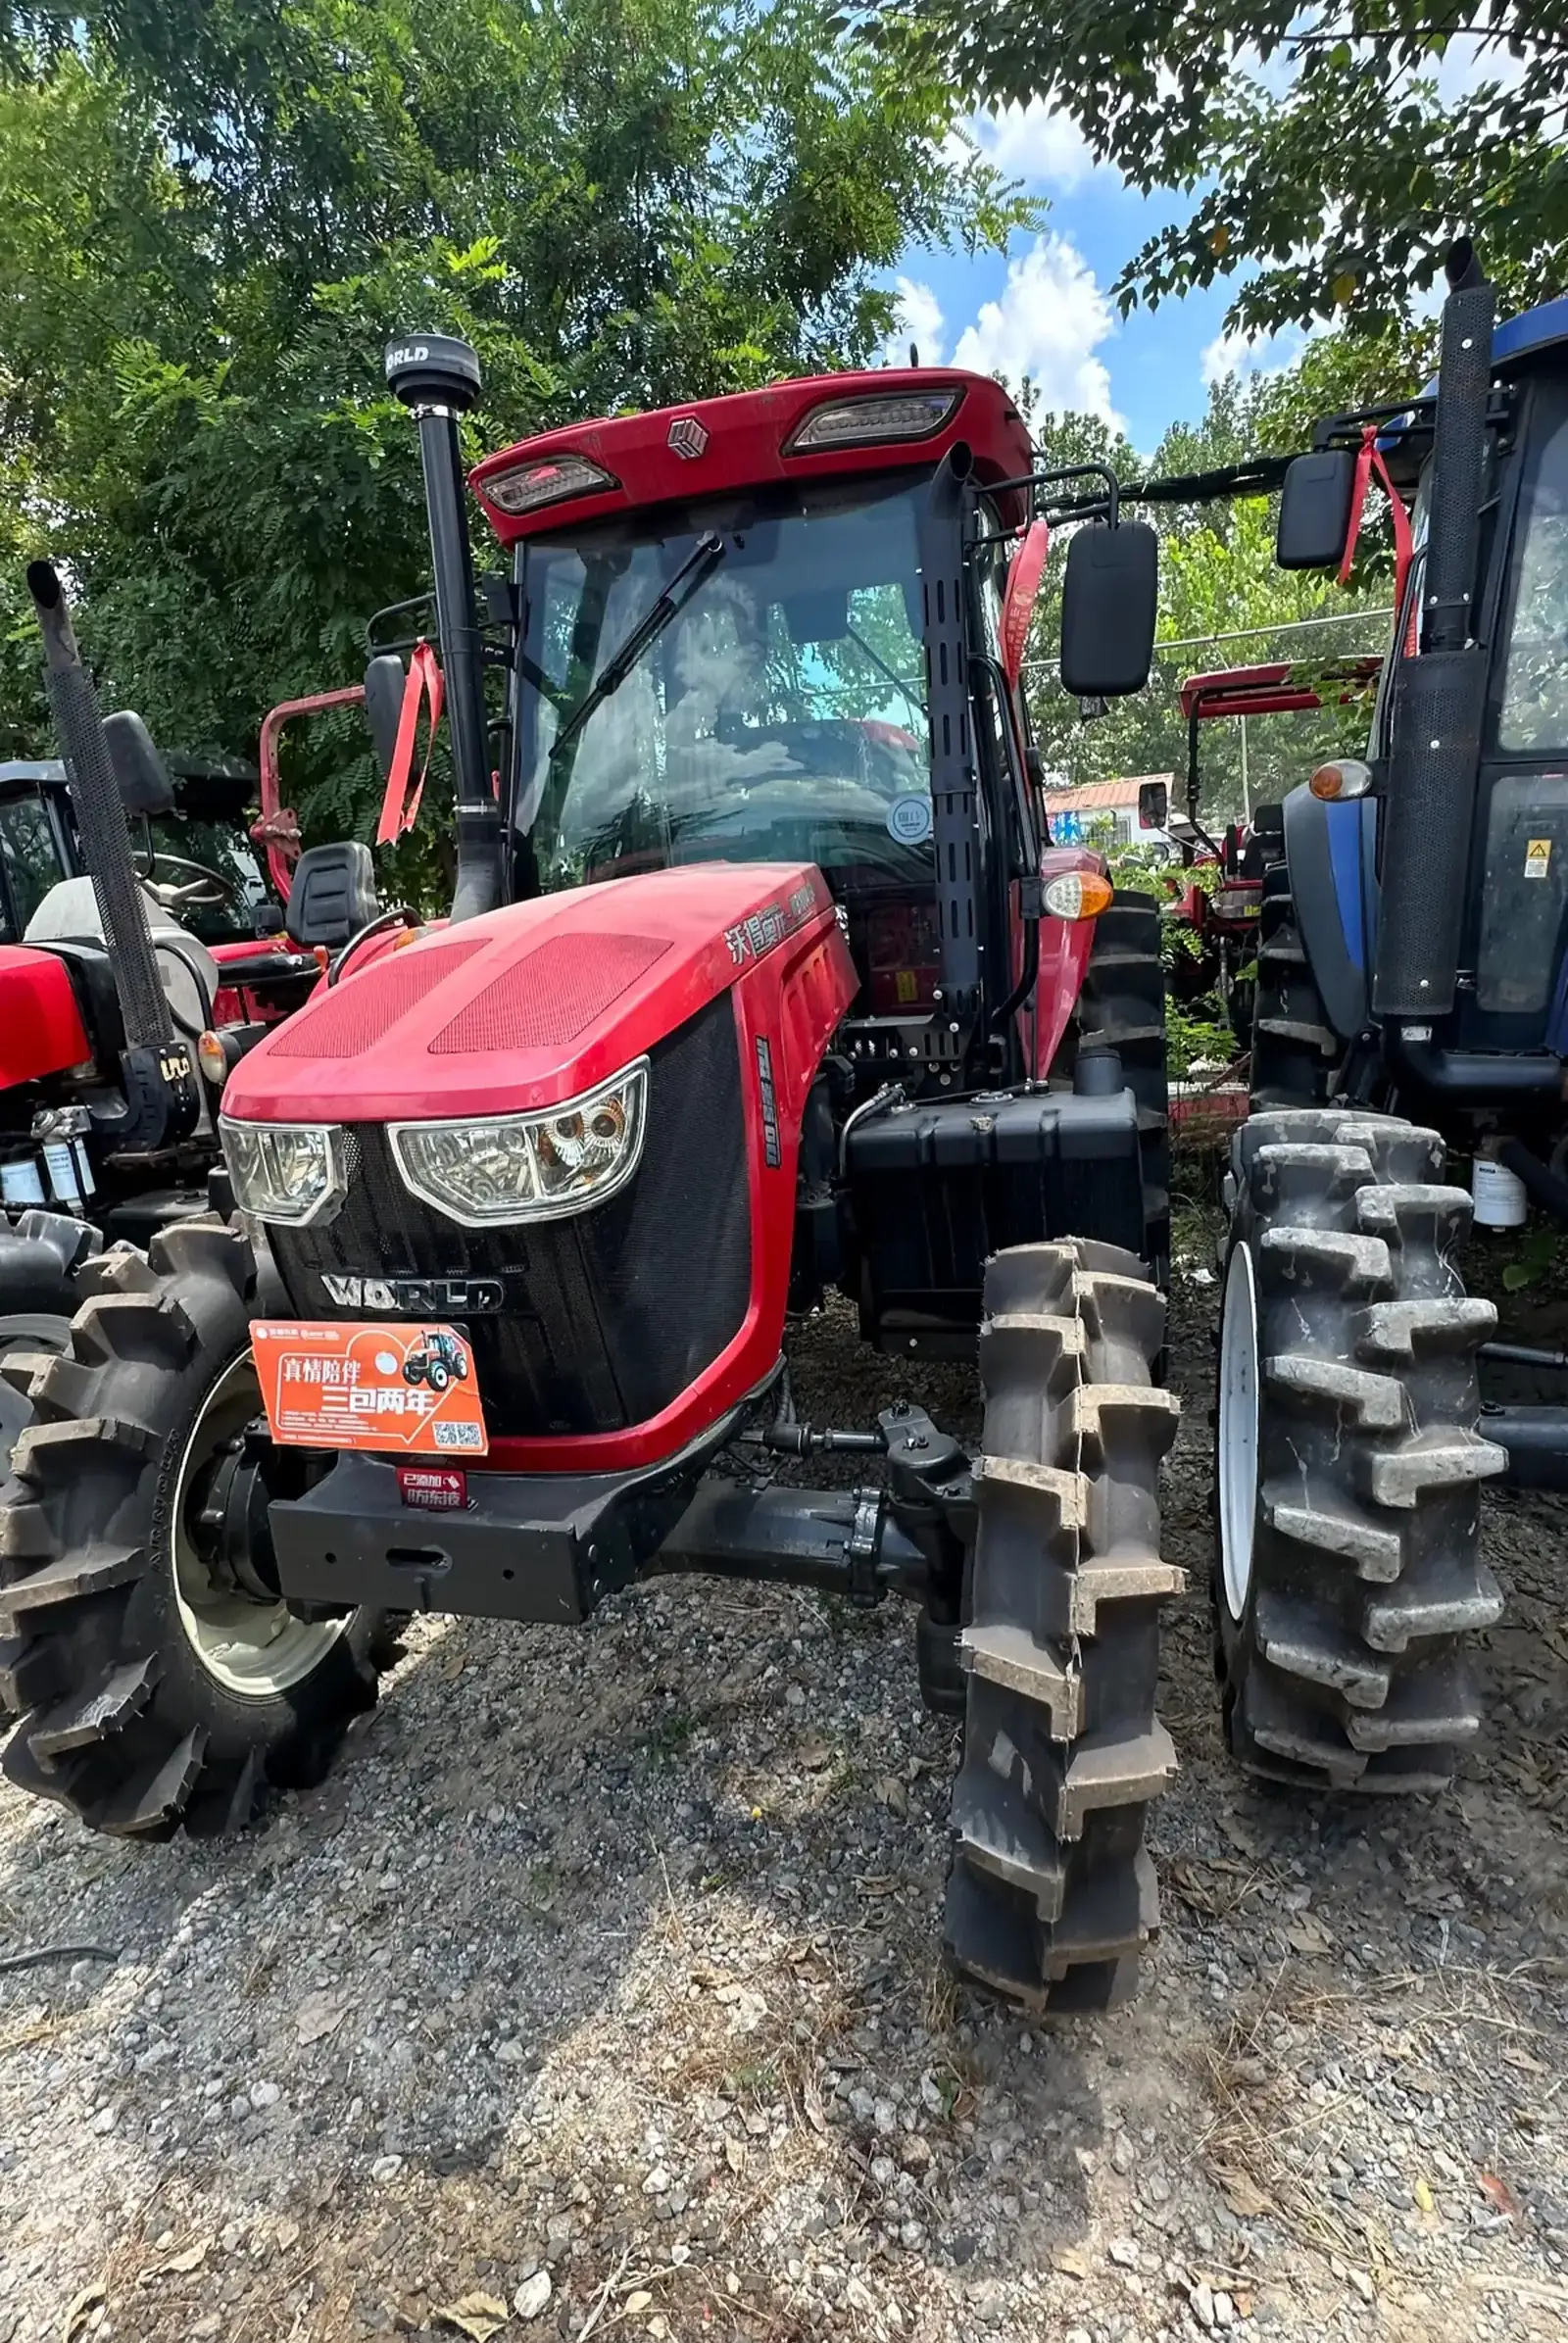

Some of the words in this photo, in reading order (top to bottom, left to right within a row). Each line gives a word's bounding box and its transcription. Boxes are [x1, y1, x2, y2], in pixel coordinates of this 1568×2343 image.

[386, 346, 429, 371] ORLD
[320, 1274, 504, 1314] WORLD
[283, 1358, 361, 1385] 真情陪伴
[320, 1385, 437, 1416] 三包两年
[403, 1473, 442, 1488] 已添加
